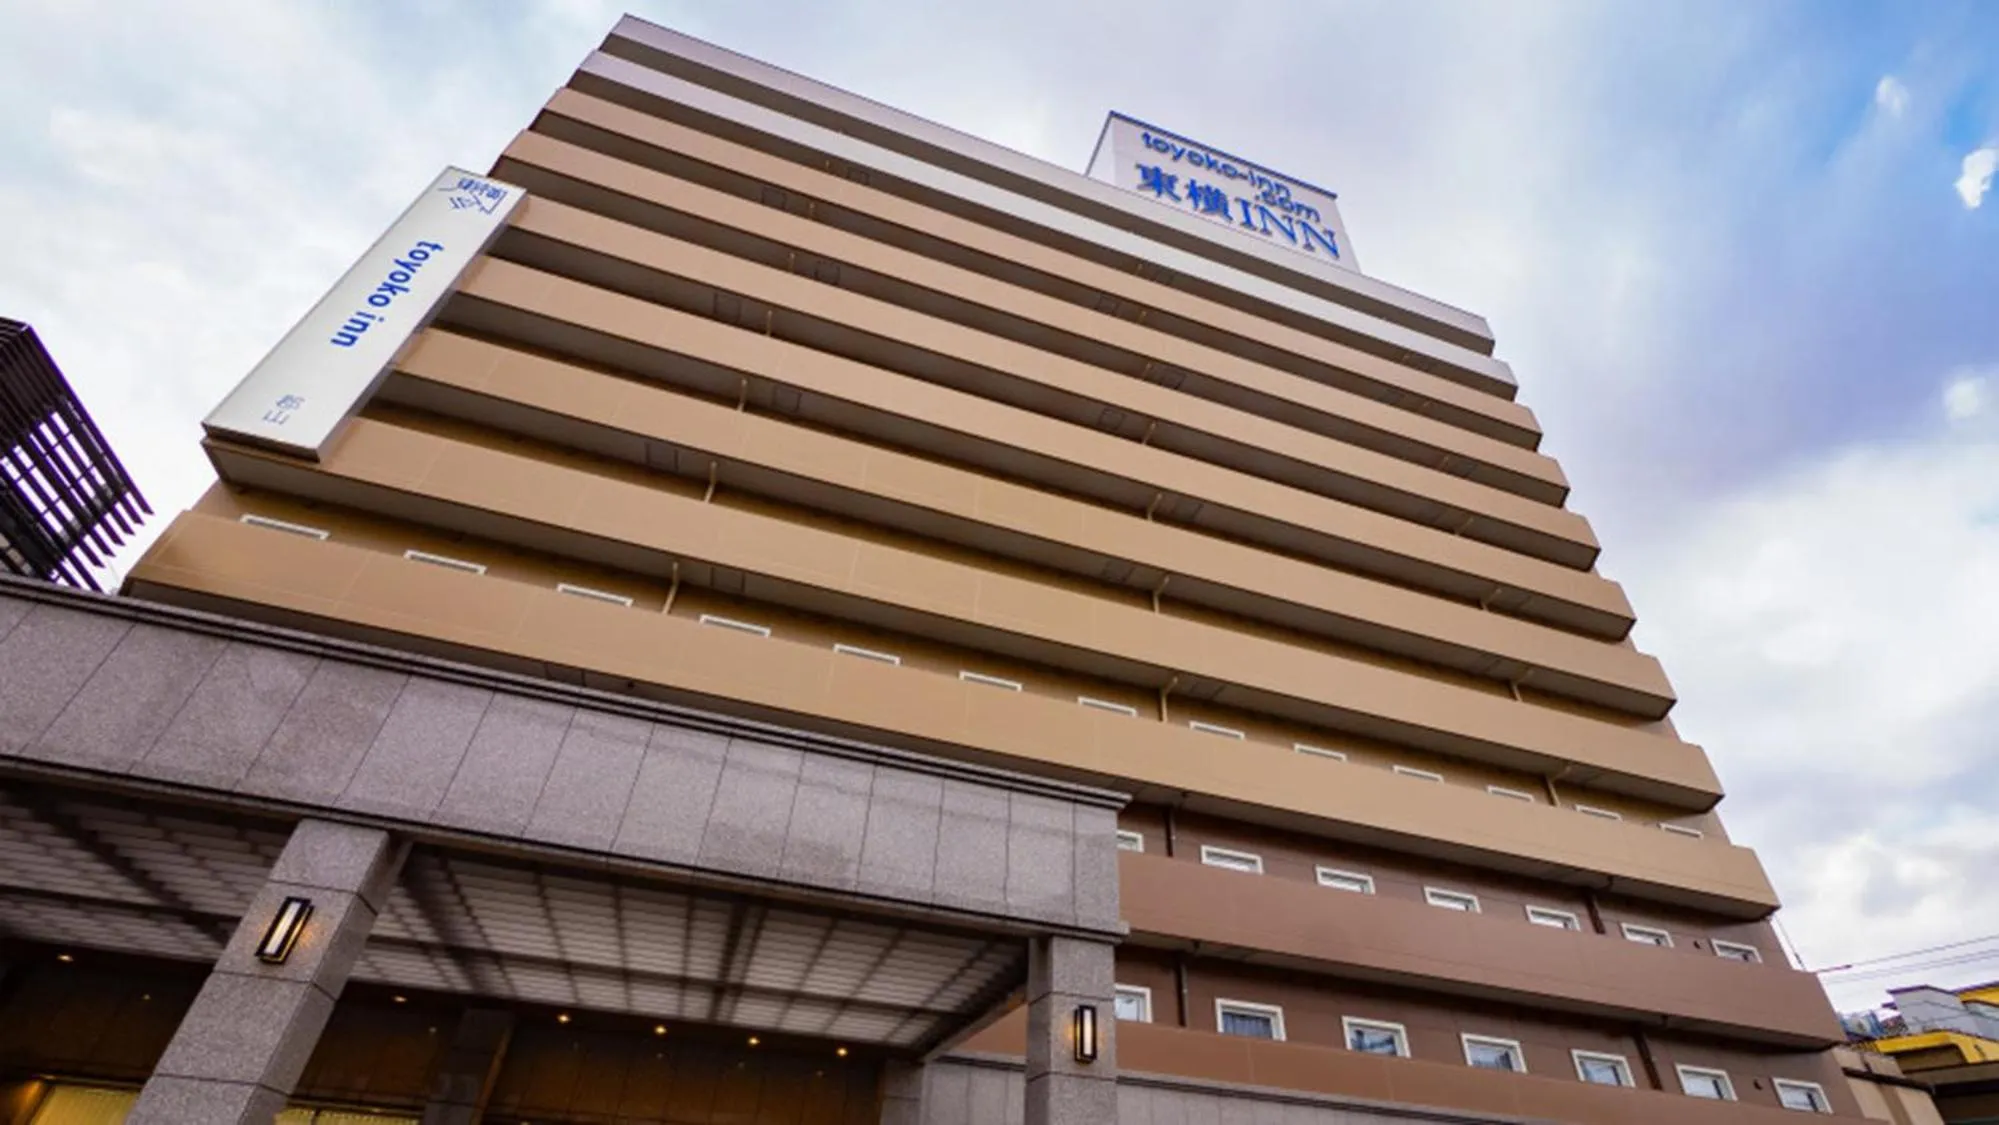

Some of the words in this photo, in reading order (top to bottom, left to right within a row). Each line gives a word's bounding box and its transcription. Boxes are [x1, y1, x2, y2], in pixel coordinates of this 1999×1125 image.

[1141, 132, 1292, 200] toyoko-inn
[1136, 163, 1340, 259] 東横INN
[368, 241, 444, 307] toyoko
[330, 311, 385, 347] inn
